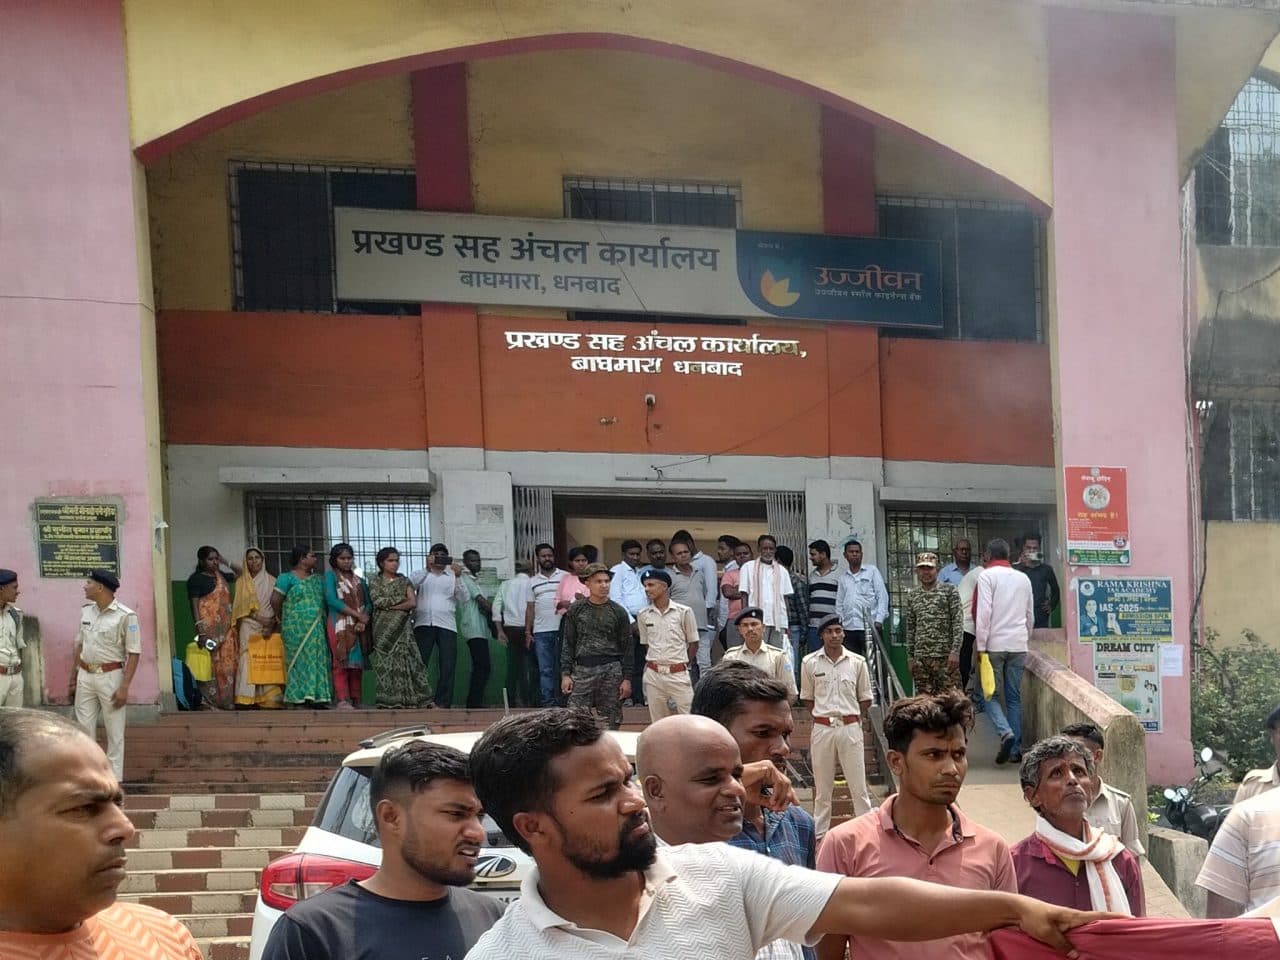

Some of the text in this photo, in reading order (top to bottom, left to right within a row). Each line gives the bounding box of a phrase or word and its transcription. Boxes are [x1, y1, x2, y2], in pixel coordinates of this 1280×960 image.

[352, 230, 720, 272] प्रखण्ड सह अंचल कार्यालय
[459, 270, 621, 295] बाघमारा, धनबाद
[813, 264, 924, 291] उज्जीवन
[504, 330, 808, 358] प्रखण्ड सह अंचल कार्यालय,
[570, 356, 742, 376] बाघमारा धनबाद
[1097, 580, 1125, 588] RAMA
[1099, 603, 1114, 612] IAS
[1096, 642, 1155, 652] DREAM CITY
